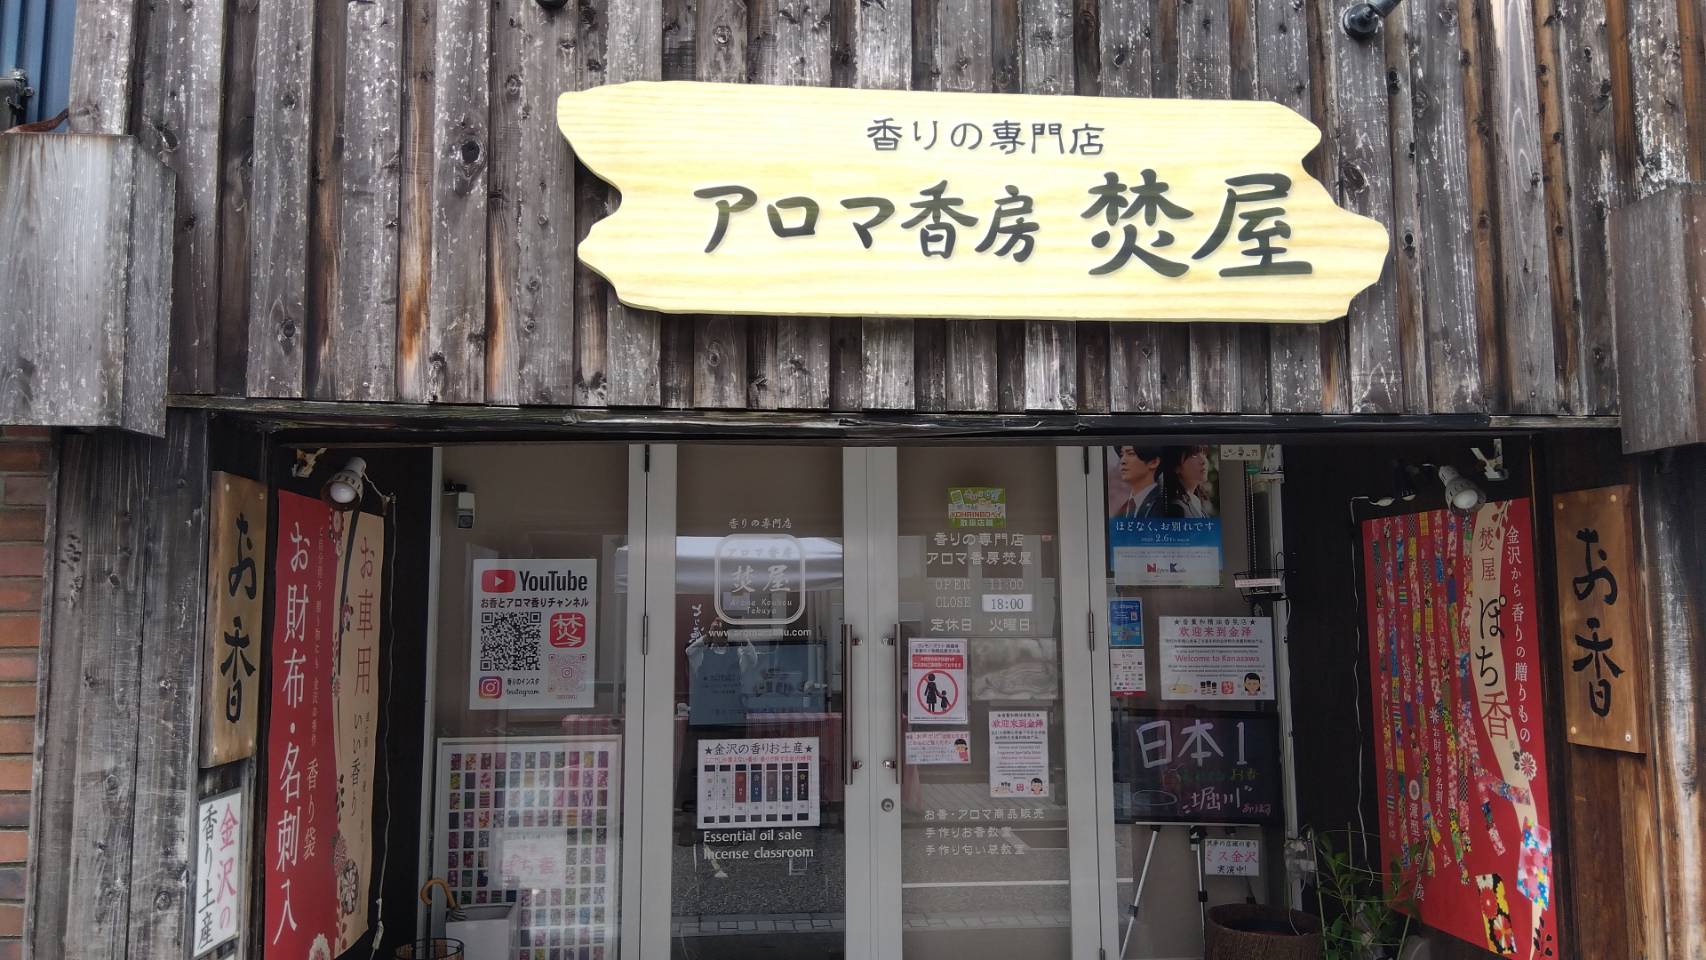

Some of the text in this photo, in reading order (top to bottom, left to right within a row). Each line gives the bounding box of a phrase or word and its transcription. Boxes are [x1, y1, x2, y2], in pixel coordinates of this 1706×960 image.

[867, 119, 1105, 155] 香りの専門店
[694, 169, 1312, 278] アロマ香房 焚屋
[728, 518, 792, 529] 香りの専門店
[1116, 521, 1215, 533] ほどなく、お別れです
[934, 533, 1024, 546] 香りの専門店
[927, 552, 1032, 565] アロマ香房焚屋
[1478, 526, 1498, 582] 焚屋
[519, 570, 588, 591] YouTube
[731, 565, 791, 592] 焚屋
[935, 579, 1024, 590] OPEN 11:00
[480, 598, 589, 609] お香とアロマ香りチャンネル
[935, 597, 1024, 609] CLOSE 18:00
[219, 513, 257, 723] お香
[354, 536, 375, 697] お車用
[1572, 527, 1625, 718] お香
[930, 618, 1030, 631] 定休日 火曜日
[1505, 525, 1531, 743] 金沢から香りの贈りもの
[1175, 655, 1260, 663] Welcome to Kanazawa
[1475, 594, 1512, 740] ぽち香
[714, 743, 804, 755] 金沢の香りお土産
[703, 829, 803, 843] Essential oil sale
[925, 827, 1012, 838] 手作りお香教室
[703, 847, 814, 860] Incense classroom
[217, 803, 239, 929] 金沢の
[198, 804, 218, 950] 香り土産
